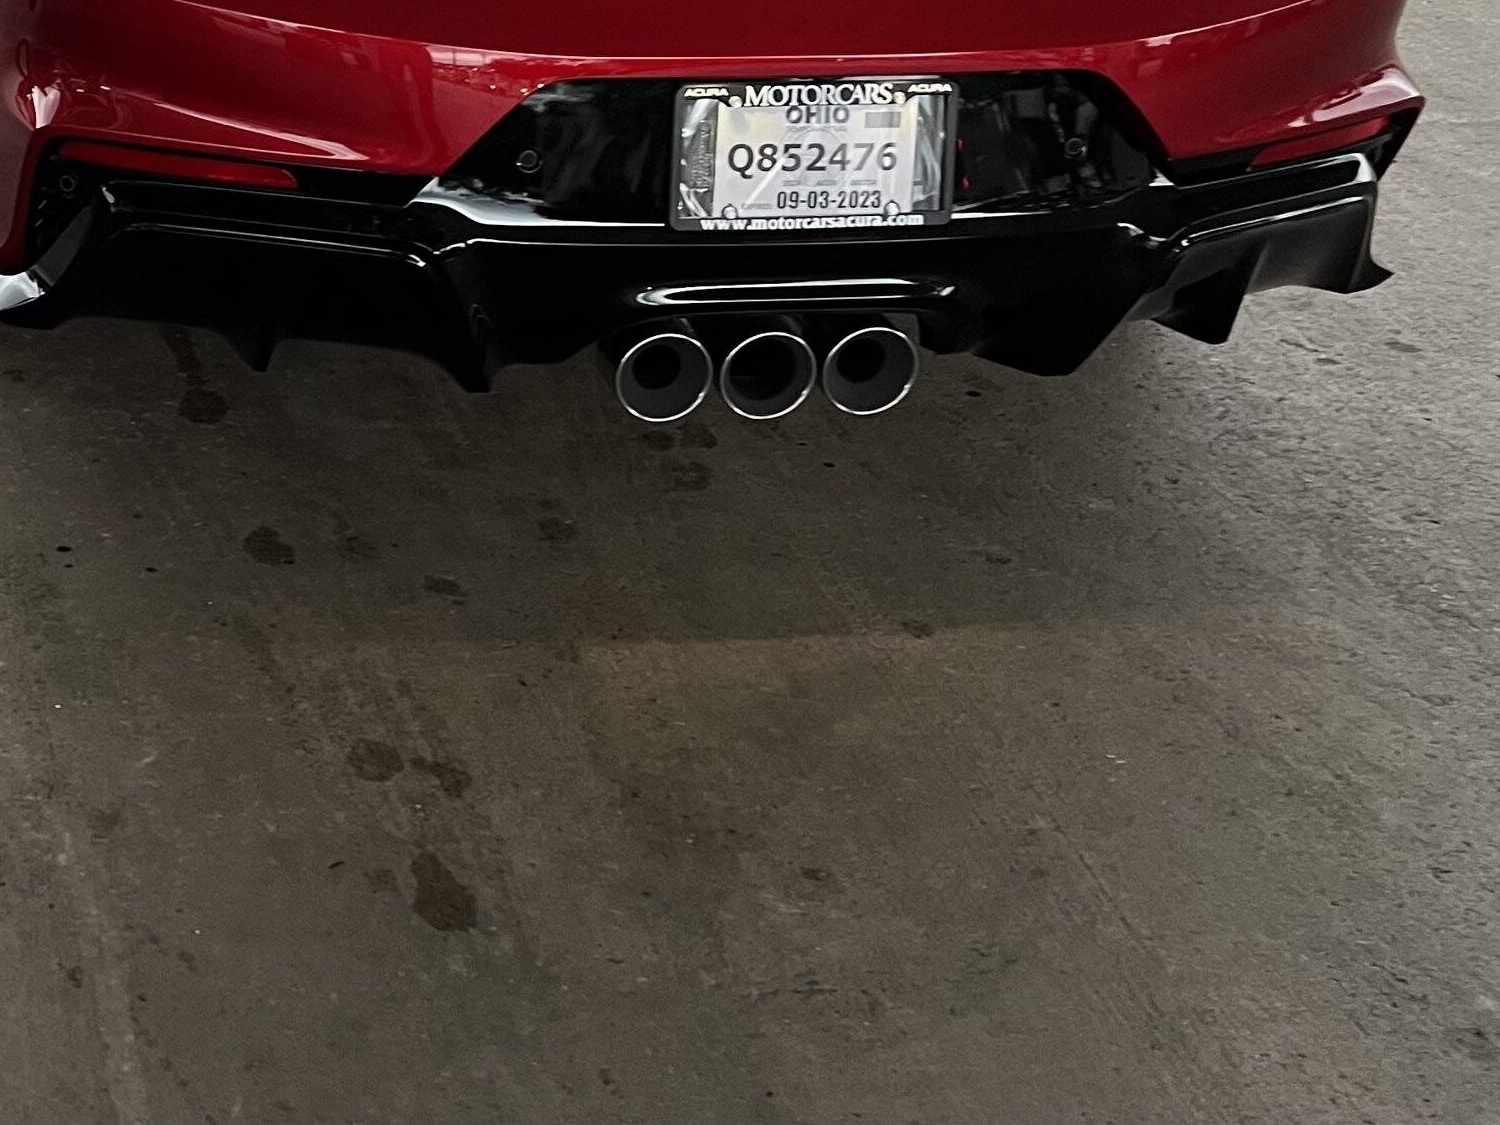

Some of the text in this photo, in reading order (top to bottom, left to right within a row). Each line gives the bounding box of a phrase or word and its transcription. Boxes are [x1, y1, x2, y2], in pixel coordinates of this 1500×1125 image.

[683, 82, 952, 108] ACURA MOTORCARS ACURA
[785, 105, 850, 125] OHIO
[727, 142, 898, 179] Q852476
[776, 190, 882, 210] 09-03-2023
[700, 214, 924, 231] www.motorcarsacura.com
